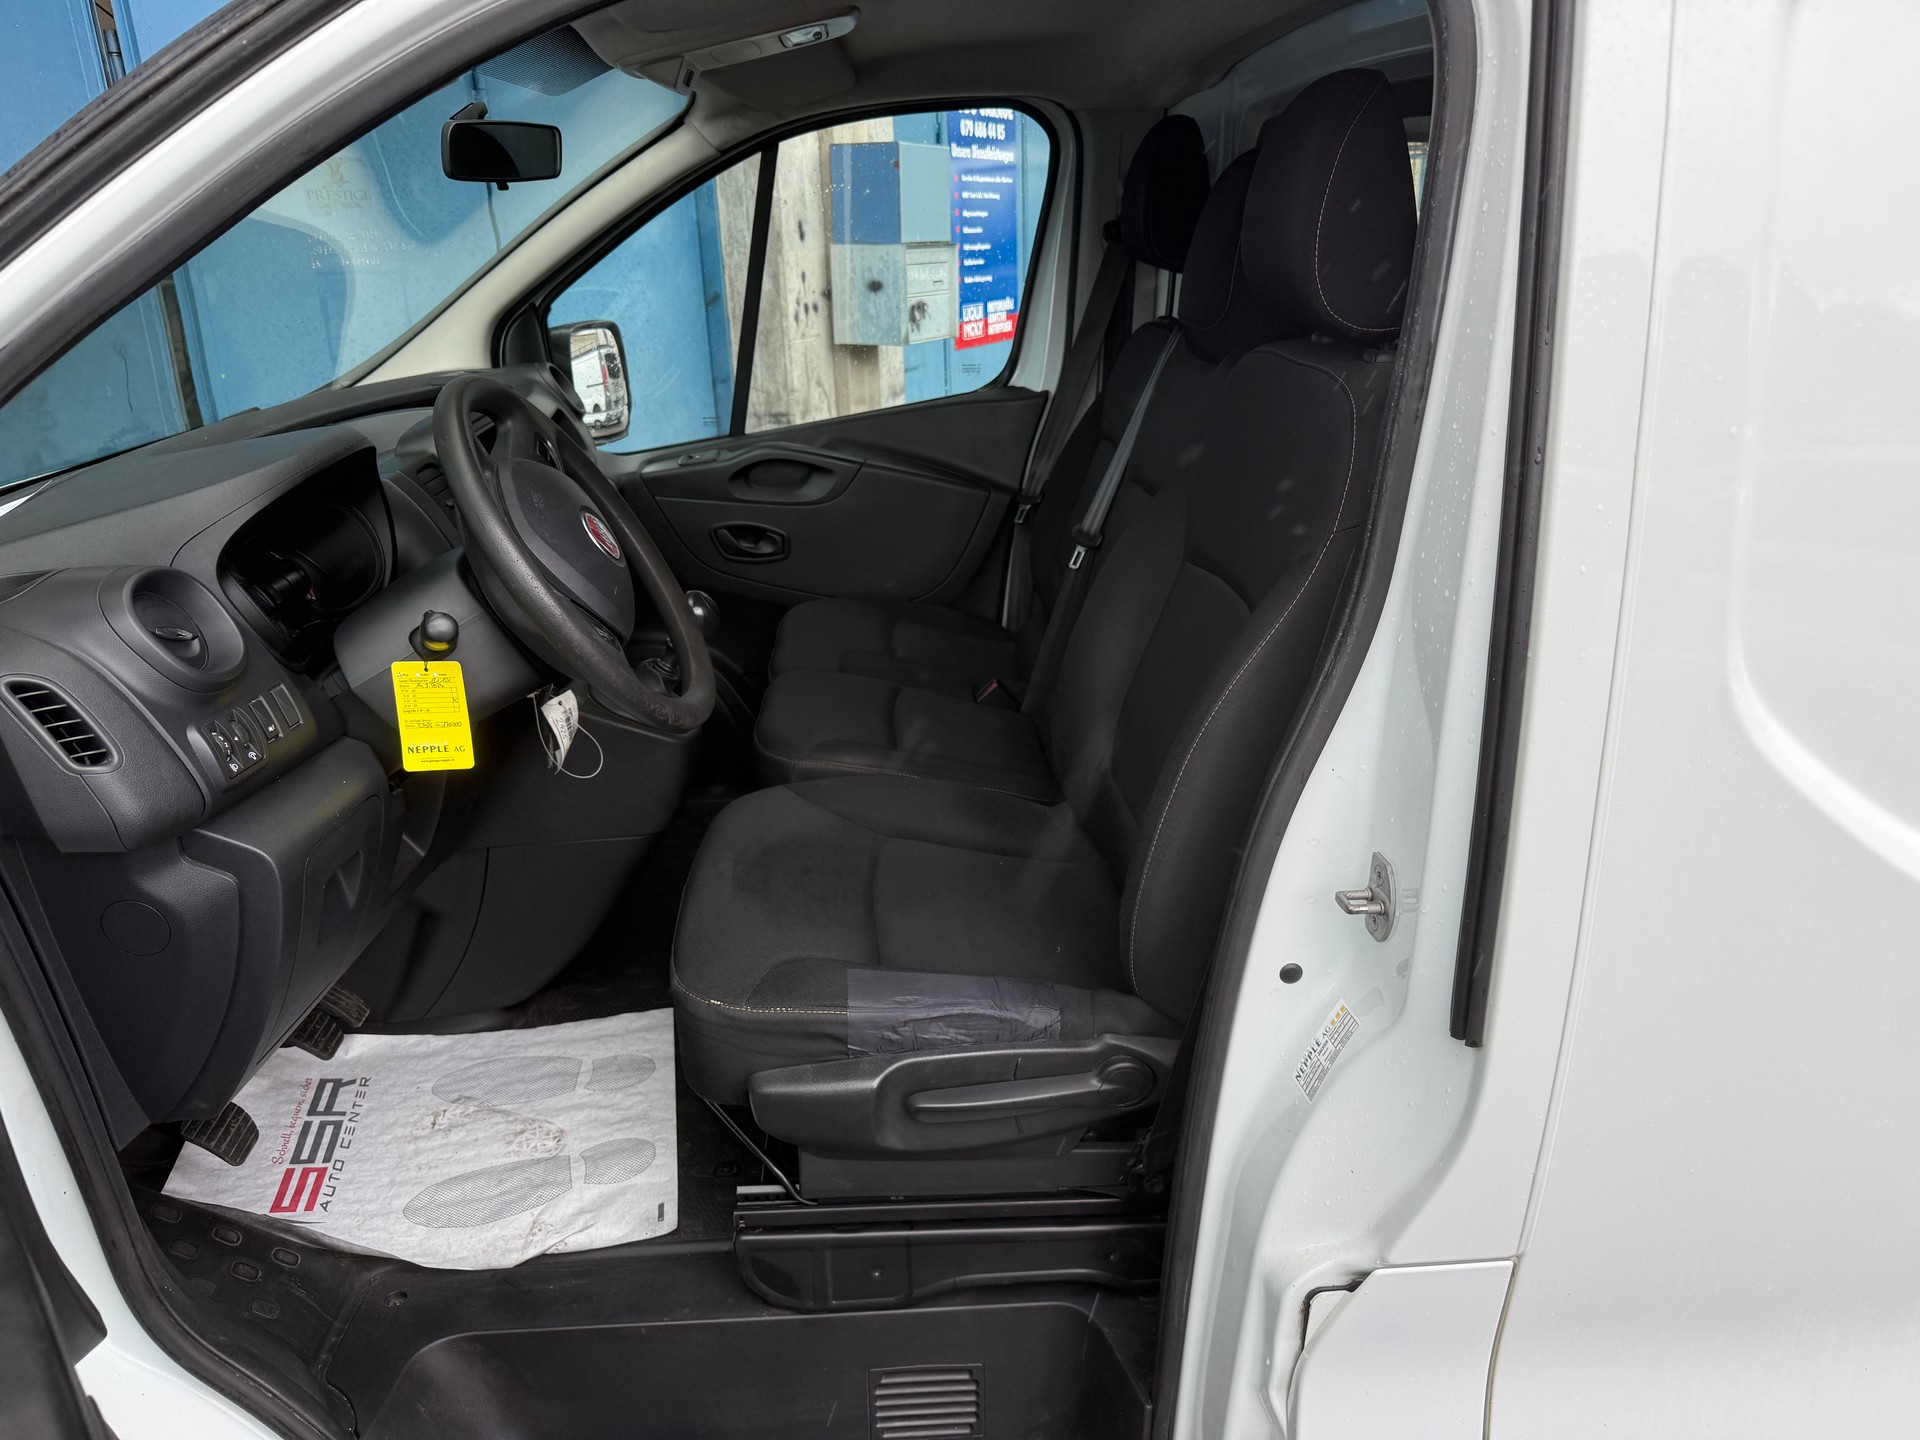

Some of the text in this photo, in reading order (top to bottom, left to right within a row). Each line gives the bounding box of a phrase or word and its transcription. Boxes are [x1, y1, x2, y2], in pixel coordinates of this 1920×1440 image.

[951, 142, 971, 159] Unsere
[407, 744, 466, 755] NEPPLE AG
[1295, 1039, 1322, 1082] NEPPLE
[269, 1078, 358, 1213] SSR
[320, 1076, 372, 1212] AUTO CENTER
